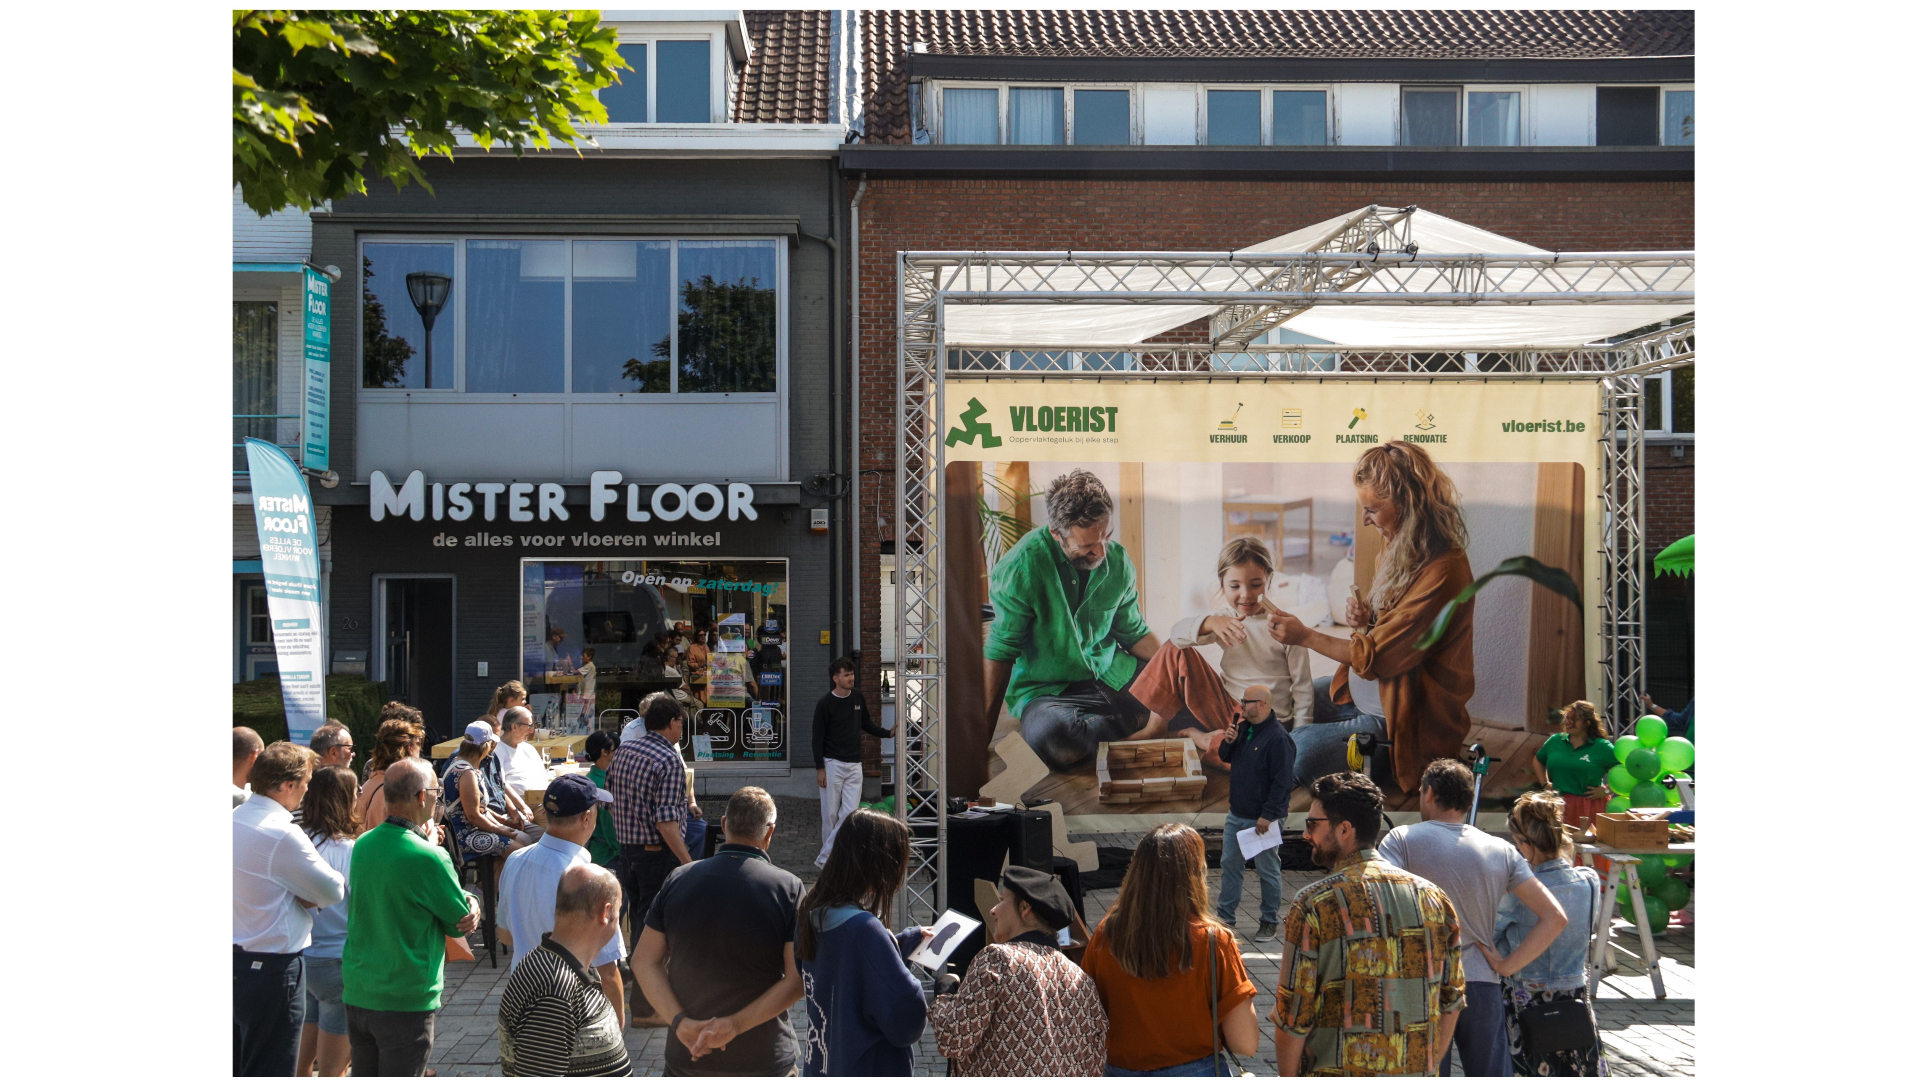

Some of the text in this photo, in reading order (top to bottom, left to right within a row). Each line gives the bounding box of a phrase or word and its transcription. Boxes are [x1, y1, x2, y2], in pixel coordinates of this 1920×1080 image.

[307, 273, 328, 298] MISTER
[308, 294, 327, 316] FLOOR
[1009, 405, 1118, 432] VLOERIST
[1502, 419, 1585, 432] vloerist.be
[1075, 436, 1084, 444] bij
[1210, 434, 1247, 443] VERHUUR
[1273, 434, 1311, 443] VERKOOP
[1336, 434, 1378, 443] PLAATSING
[1404, 434, 1447, 443] RENOVATIE
[370, 469, 758, 522] MISTER FLOOR
[432, 531, 721, 547] de alles voor vloeren winkel
[621, 570, 779, 597] Open op zaterdag!
[342, 616, 359, 630] 26
[697, 751, 735, 759] Plaatsing
